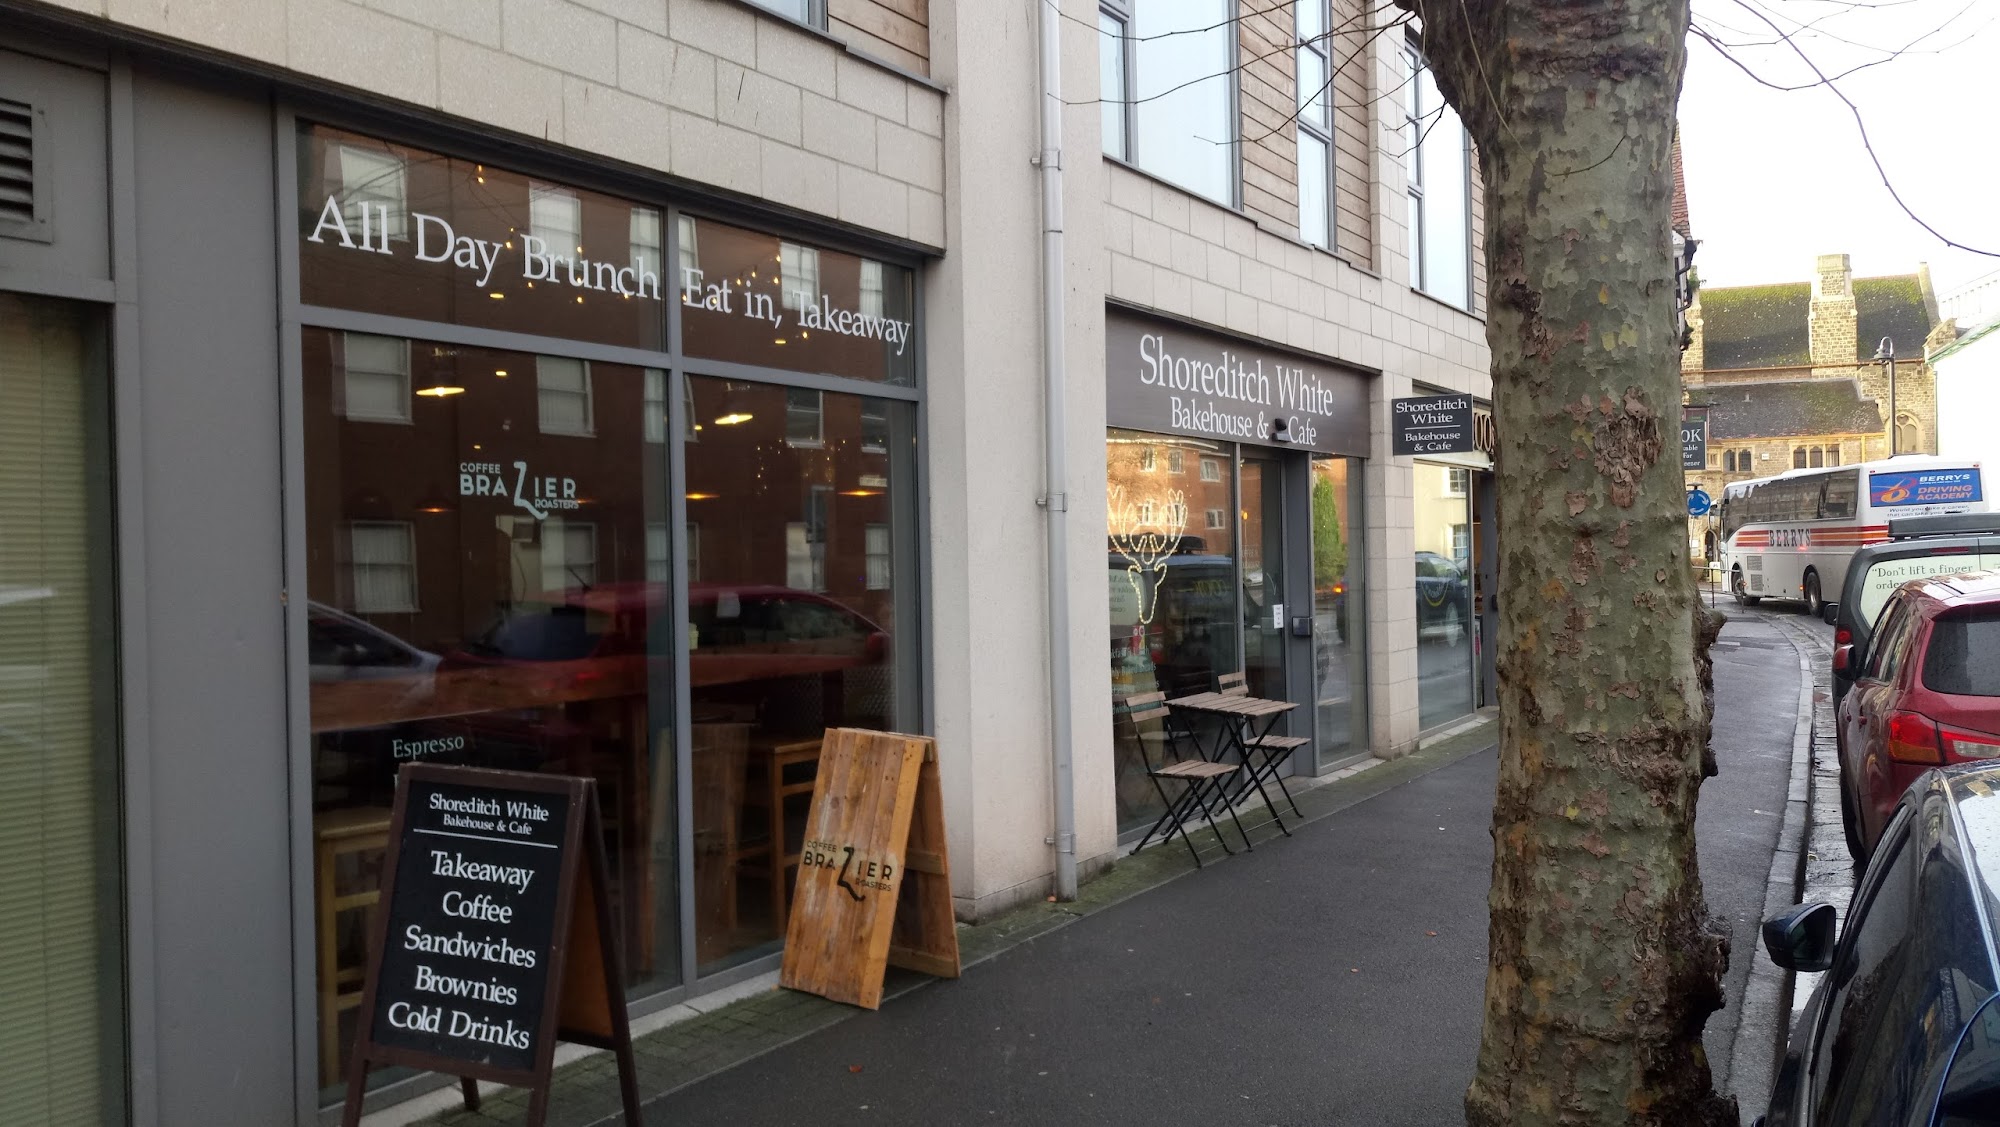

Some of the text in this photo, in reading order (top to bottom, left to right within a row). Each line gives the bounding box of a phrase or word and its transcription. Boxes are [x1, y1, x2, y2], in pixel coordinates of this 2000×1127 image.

[308, 194, 661, 302] All Day Brunch
[683, 267, 911, 356] Eat in, Takeaway
[1140, 334, 1334, 417] Shoreditch White
[1396, 398, 1468, 414] Shoreditch
[1170, 396, 1317, 447] Bakehouse & Cafe
[1411, 413, 1454, 425] White
[1405, 431, 1461, 442] Bakehouse
[1680, 428, 1703, 443] OK
[1414, 441, 1452, 452] & Cafe
[460, 462, 501, 474] COFFEE
[1920, 473, 1971, 482] BERRYS
[460, 461, 577, 520] BRAZIER
[1916, 491, 1973, 501] ACADEMY
[1917, 484, 1973, 494] DRIVING
[534, 498, 580, 510] ROASTERS
[1769, 528, 1811, 547] BERRYS
[1909, 565, 1925, 575] lift
[1939, 564, 1973, 574] finger
[392, 736, 465, 761] Espresso
[429, 793, 549, 822] Shoreditch White
[443, 814, 532, 835] Bakehouse & Cafe
[806, 840, 838, 853] COFFEE
[430, 850, 535, 895] Takeaway
[803, 846, 893, 902] BRAZIER
[855, 877, 892, 892] ROASTERS
[442, 890, 513, 924] Coffee
[404, 924, 536, 968] Sandwiches
[415, 964, 518, 1006] Brownies
[388, 1001, 530, 1050] Cold Drinks
